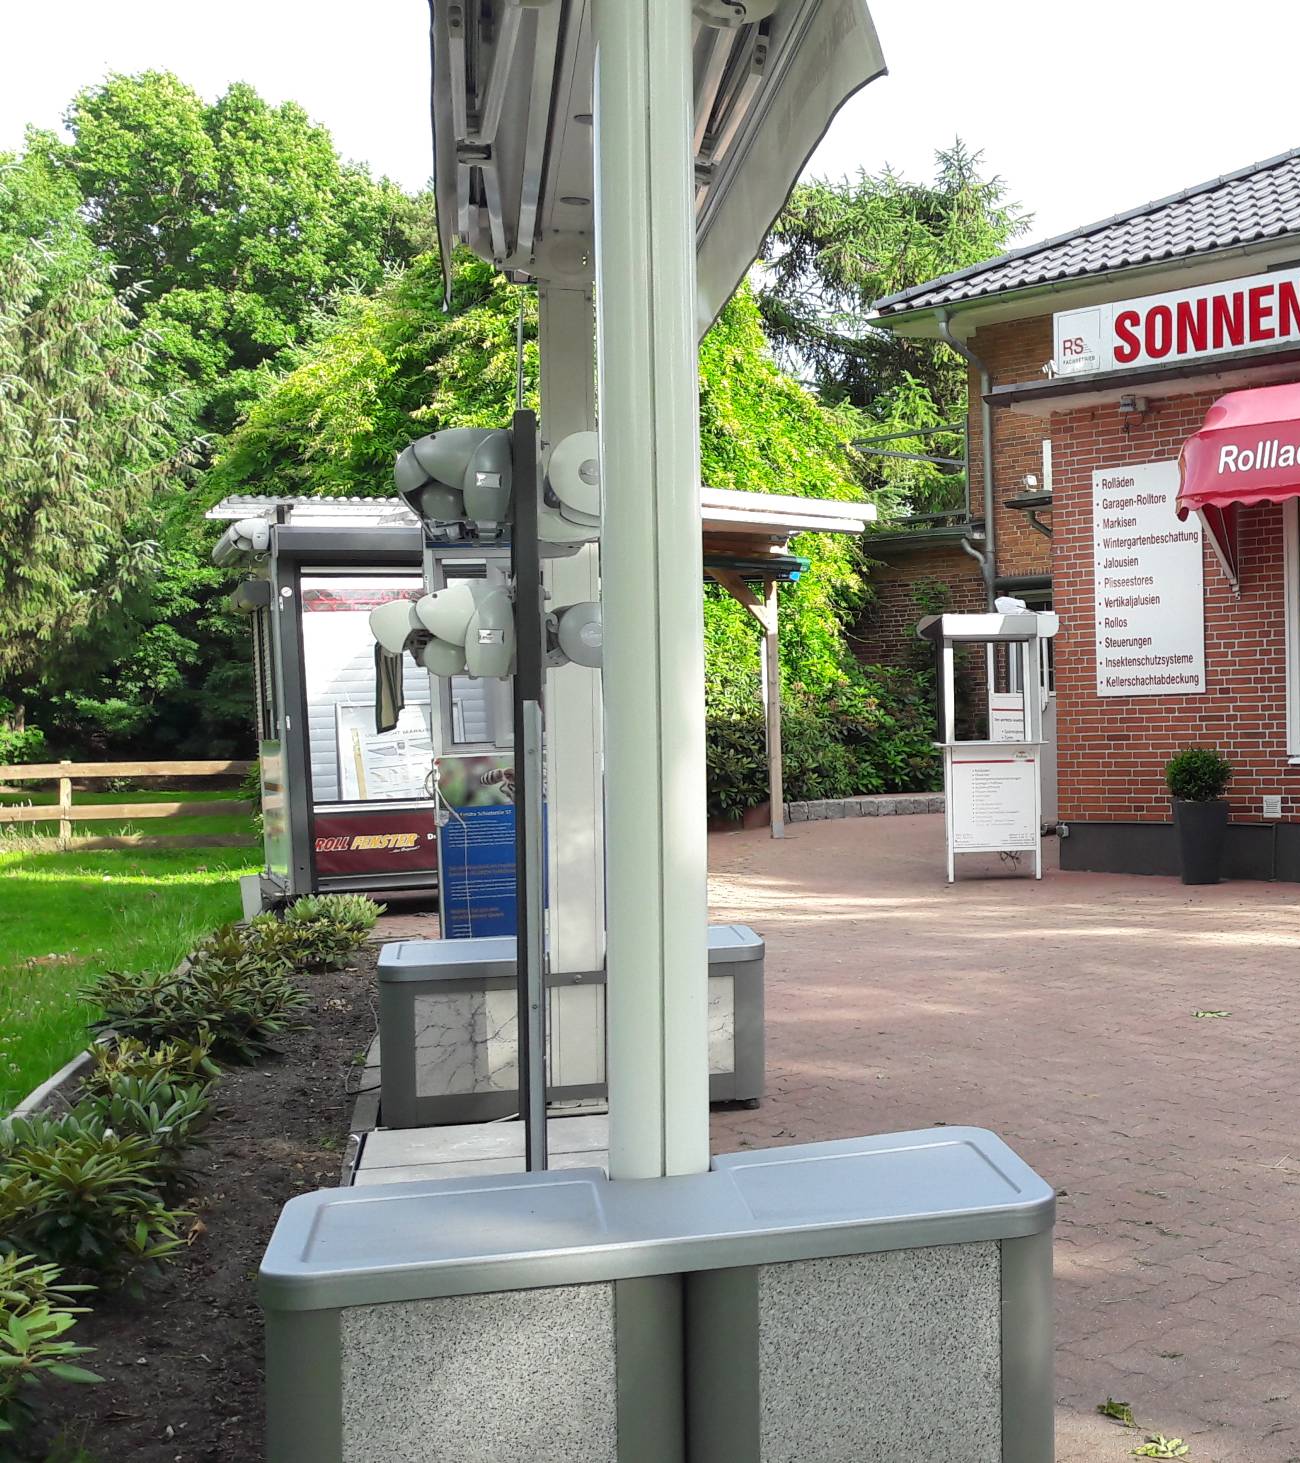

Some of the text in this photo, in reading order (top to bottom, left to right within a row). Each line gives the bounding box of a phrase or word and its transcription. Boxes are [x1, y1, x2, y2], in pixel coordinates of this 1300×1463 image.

[1062, 337, 1085, 358] RS
[1101, 476, 1135, 490] Rolläden
[1102, 493, 1167, 510] Garagen-Rolltore
[1102, 517, 1137, 530] Markisen
[1103, 531, 1199, 549] Wintergartenbeschattung
[1103, 555, 1139, 569] Jalousien
[1104, 575, 1154, 589] Plisseestores
[1104, 617, 1128, 629] Rollos
[1105, 636, 1152, 649] Steuerungen
[1105, 653, 1194, 668] Insektenschutzsysteme
[1106, 673, 1200, 687] Kellerschachtabdeckung
[315, 837, 350, 852] ROLL
[350, 833, 418, 850] FENSTER
